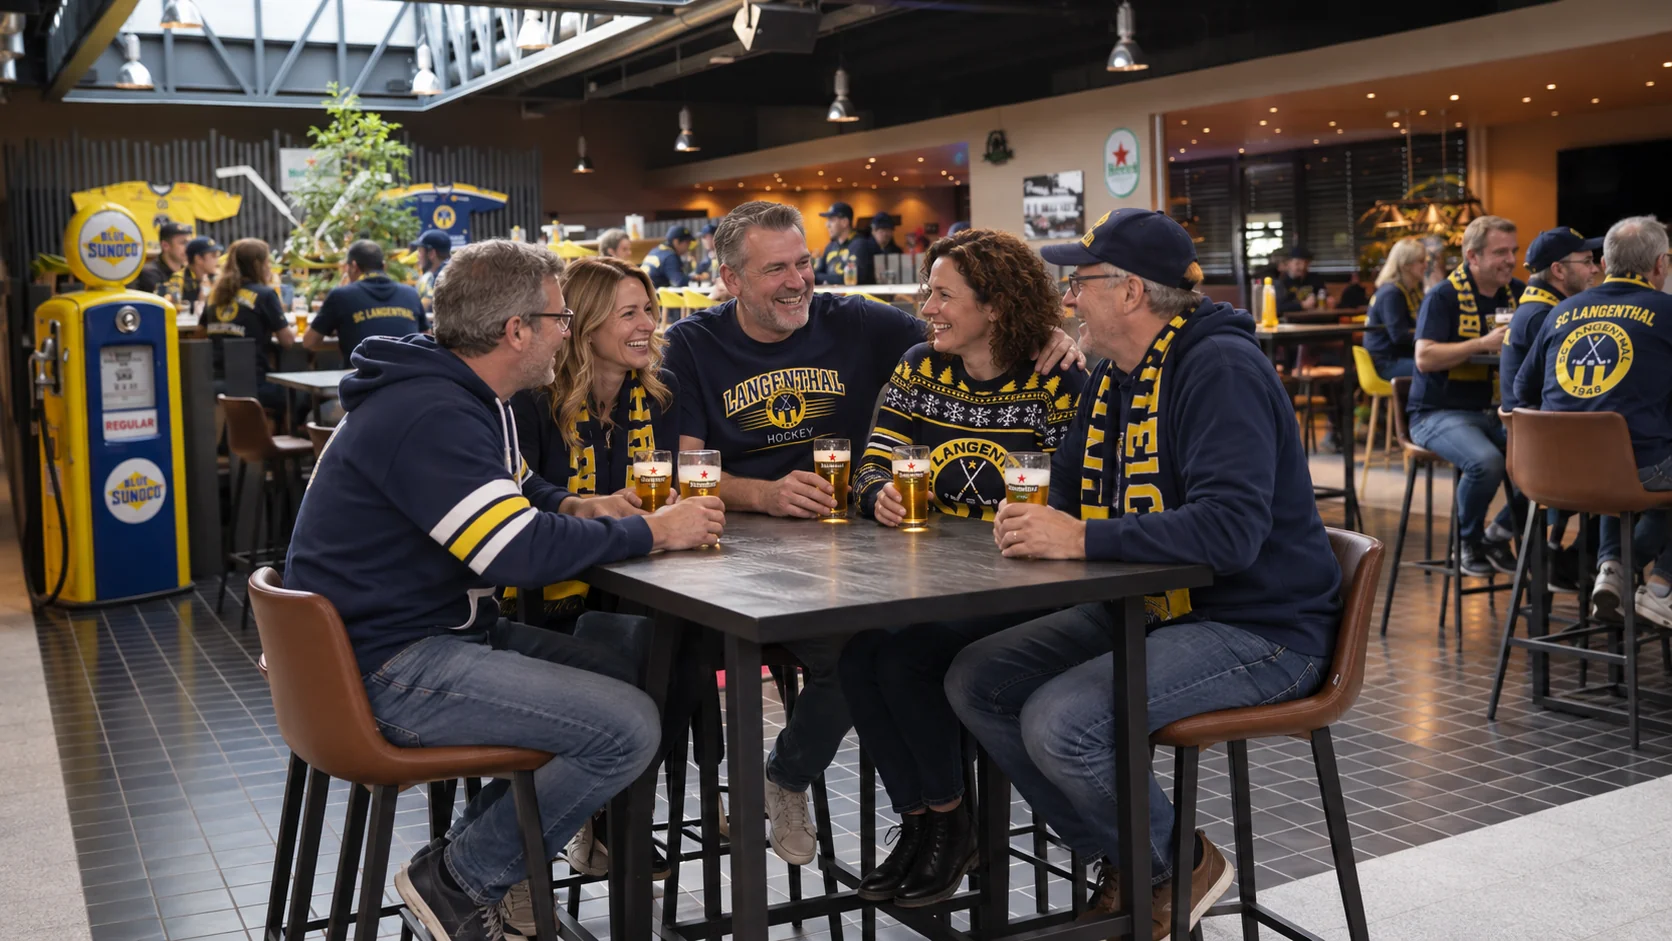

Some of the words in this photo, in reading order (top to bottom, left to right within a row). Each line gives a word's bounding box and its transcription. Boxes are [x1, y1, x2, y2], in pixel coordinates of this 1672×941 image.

[101, 231, 125, 242] BLUE
[88, 242, 138, 259] SUNOCO
[1555, 311, 1570, 329] SC
[1571, 304, 1656, 327] LANGENTHAL
[723, 368, 846, 418] LANGENTHAL
[105, 418, 154, 431] REGULAR
[767, 427, 814, 444] HOCKEY
[124, 476, 148, 487] BLUE
[112, 485, 162, 505] SUNOCO
